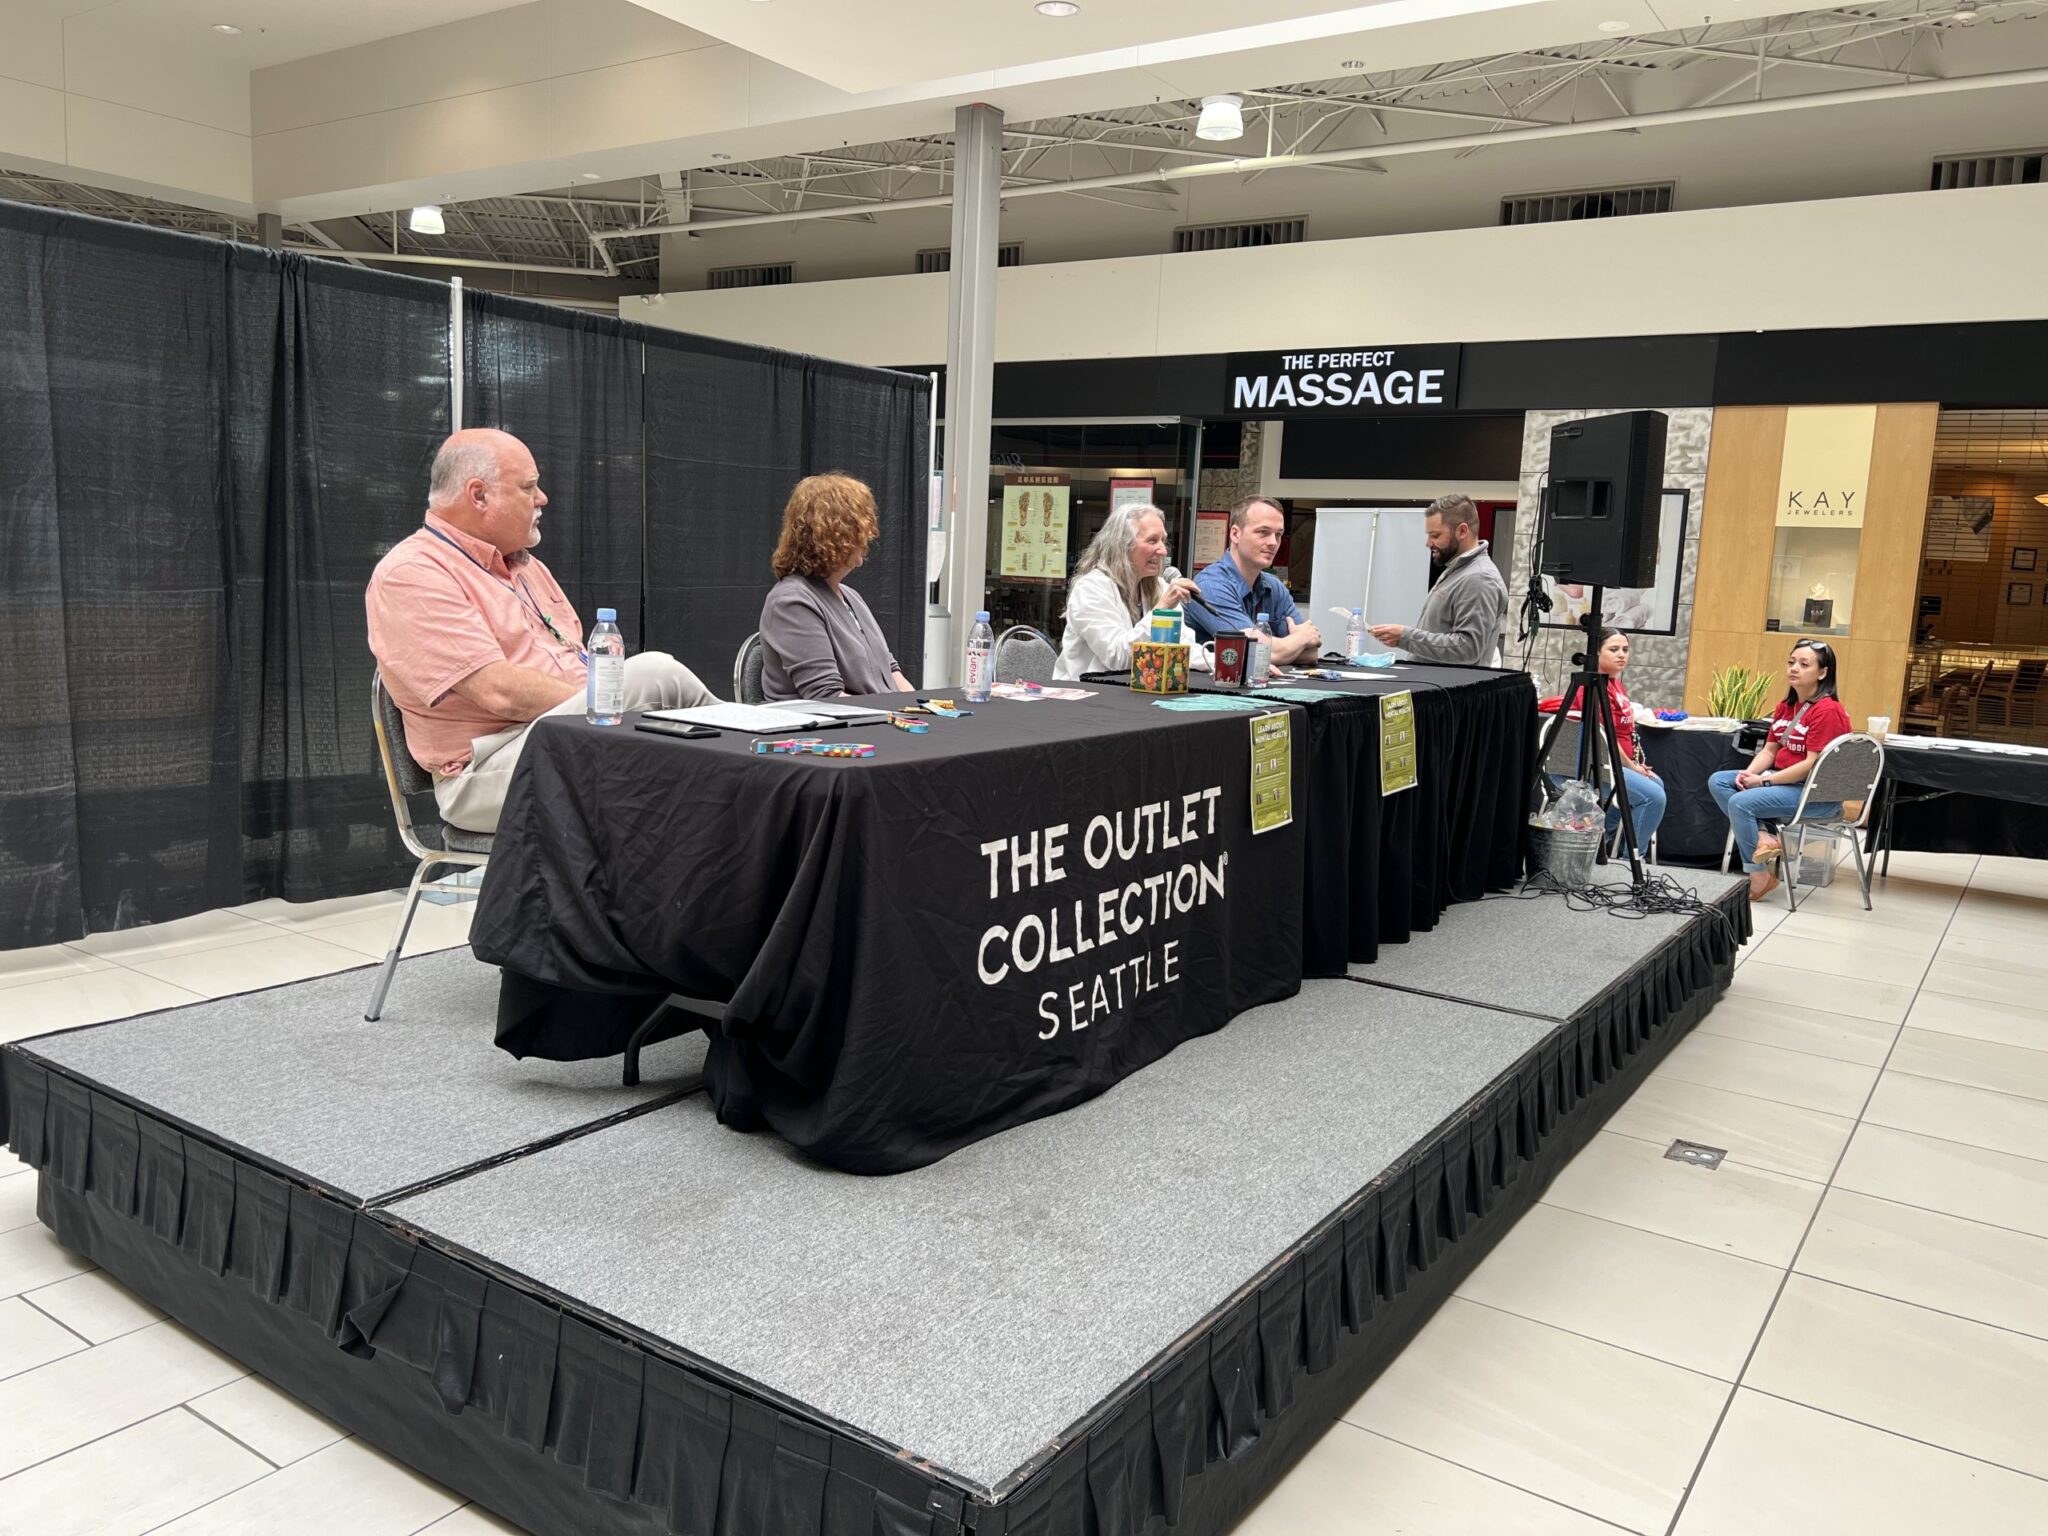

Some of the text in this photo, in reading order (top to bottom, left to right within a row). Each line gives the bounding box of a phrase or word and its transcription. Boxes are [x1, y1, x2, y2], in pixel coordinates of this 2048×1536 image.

[1282, 351, 1395, 370] THE PERFECT
[1233, 369, 1445, 409] MASSAGE
[1788, 491, 1855, 509] KAY
[969, 657, 977, 684] evian
[980, 786, 1222, 899] THE OUTLET
[1038, 940, 1180, 1040] SEATTLE
